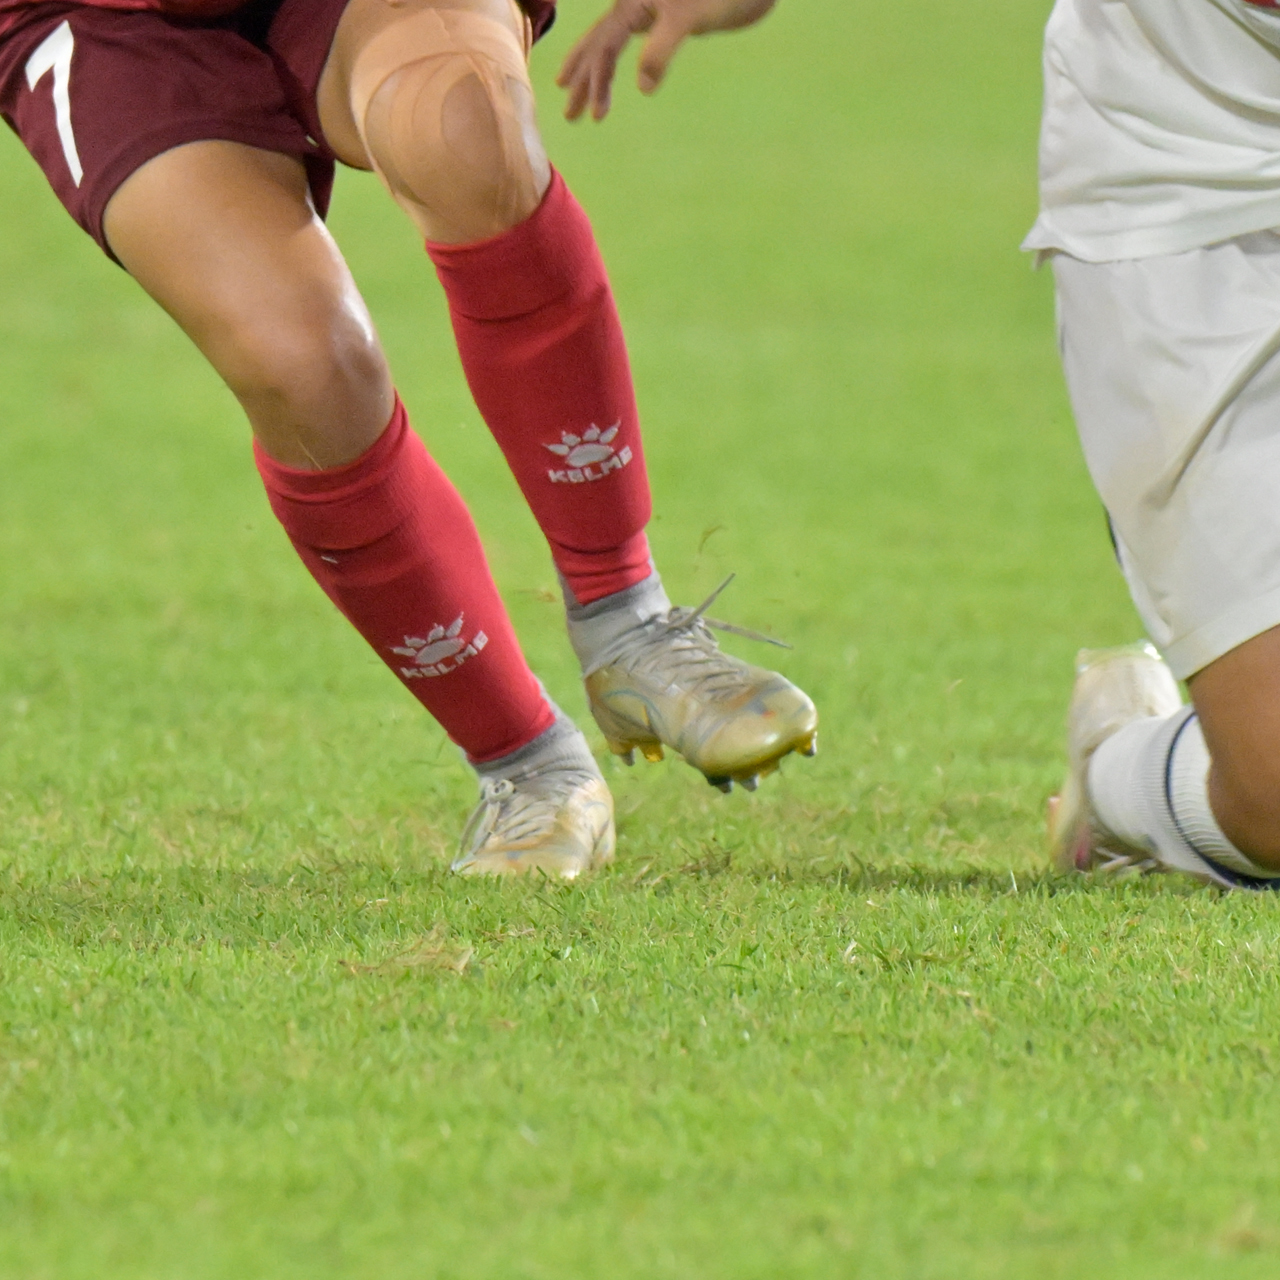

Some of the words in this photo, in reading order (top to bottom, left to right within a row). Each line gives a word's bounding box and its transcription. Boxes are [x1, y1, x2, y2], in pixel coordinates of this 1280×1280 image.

[25, 20, 84, 188] 7
[547, 445, 633, 484] KELME
[400, 630, 489, 679] KELME
